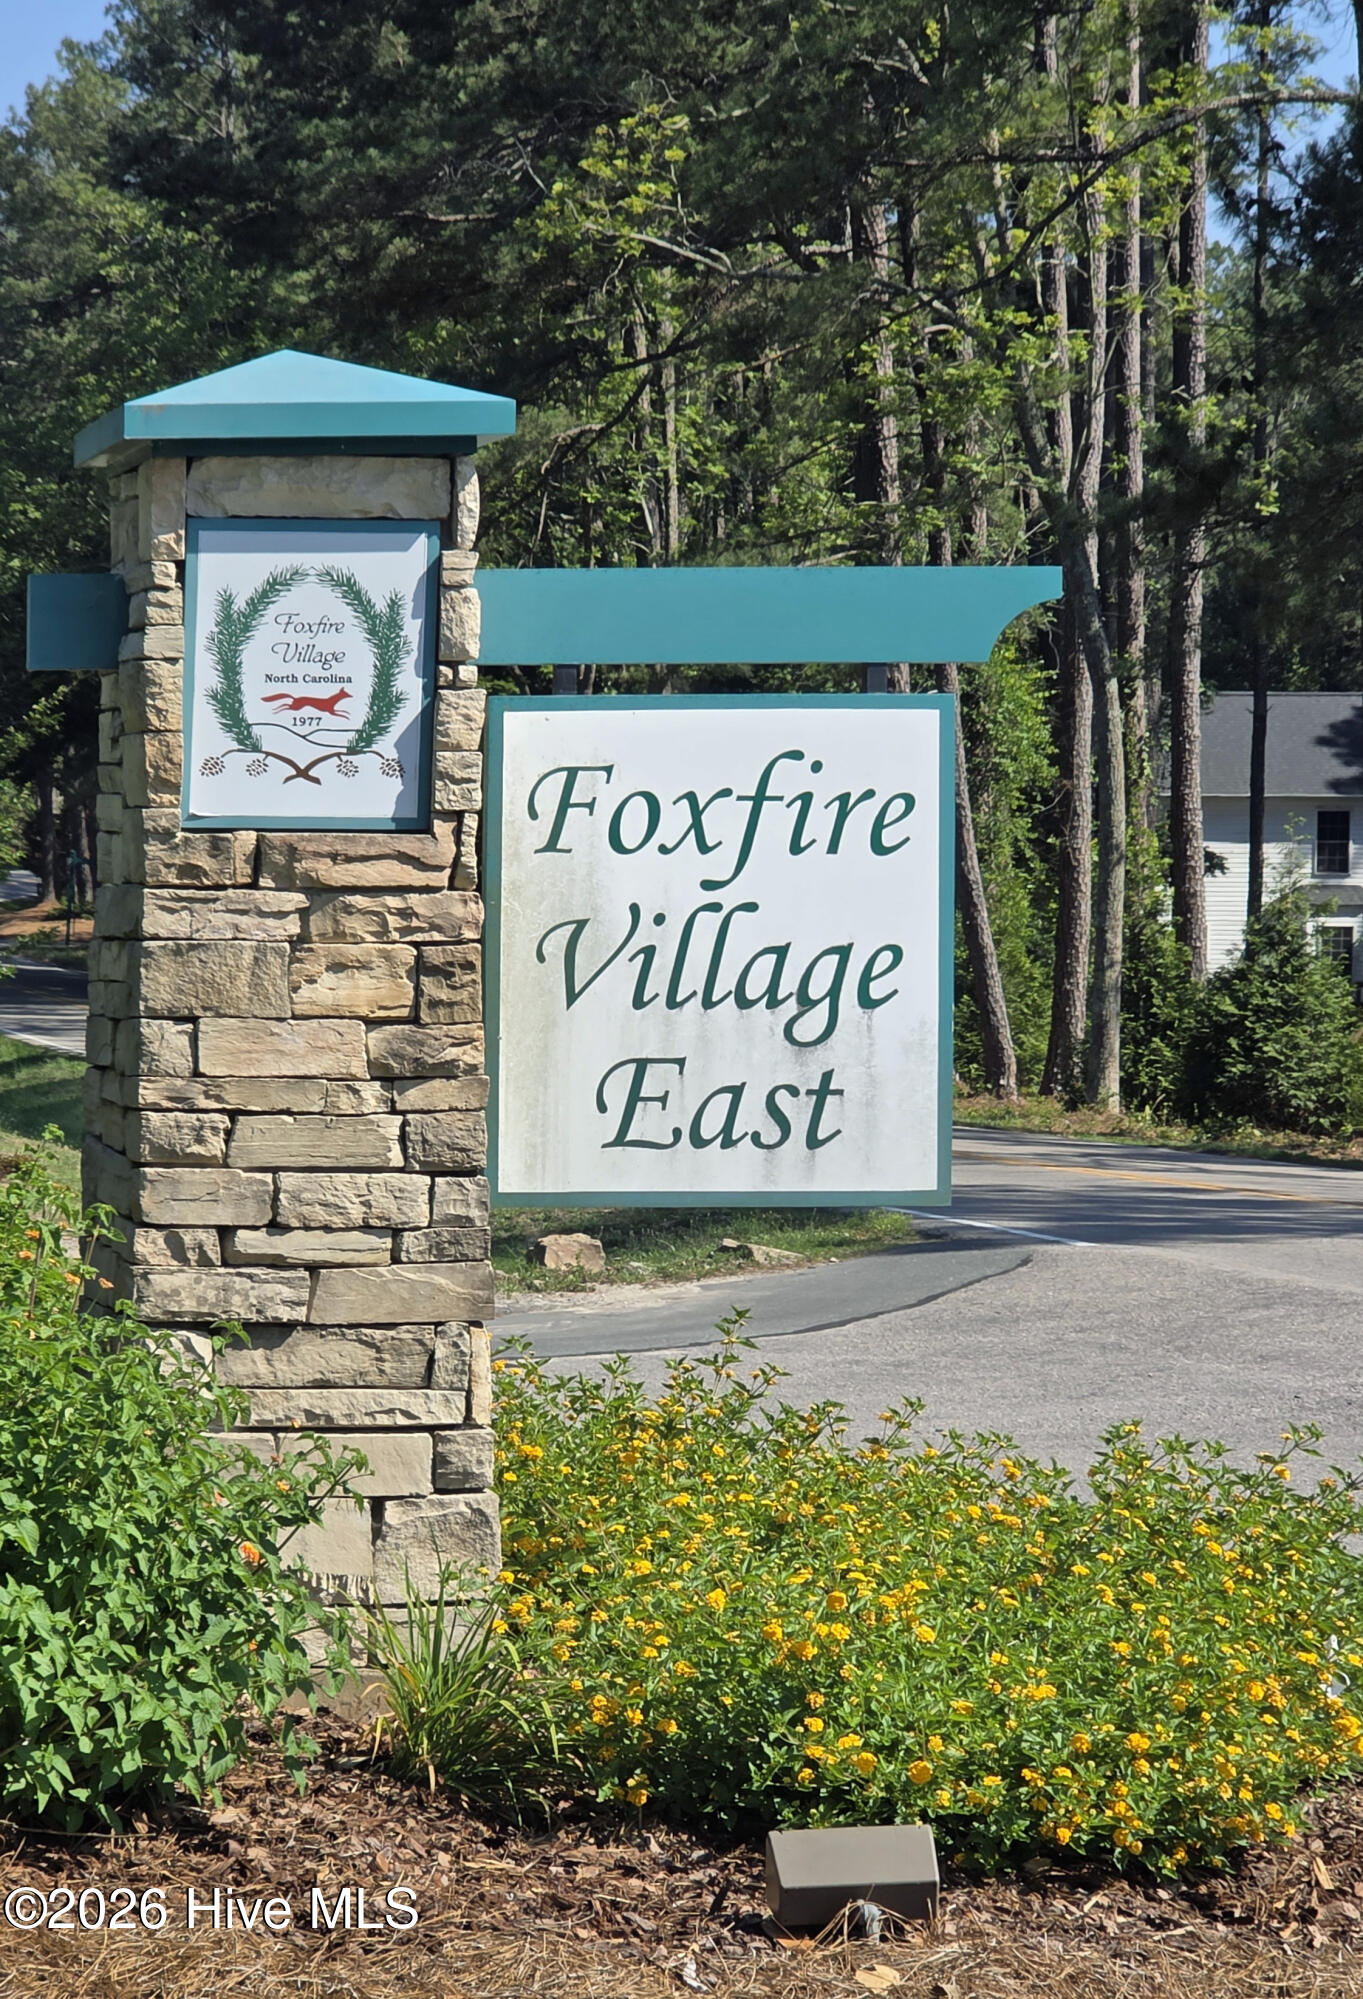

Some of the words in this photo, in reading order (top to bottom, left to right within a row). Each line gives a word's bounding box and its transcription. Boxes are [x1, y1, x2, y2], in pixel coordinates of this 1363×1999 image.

[274, 612, 345, 639] Foxfire
[271, 641, 346, 671] Village
[264, 673, 298, 684] North
[302, 674, 352, 684] Carolina
[292, 717, 322, 727] 1977
[526, 748, 917, 892] Foxfire
[535, 900, 904, 1049] Village
[595, 1055, 845, 1151] East
